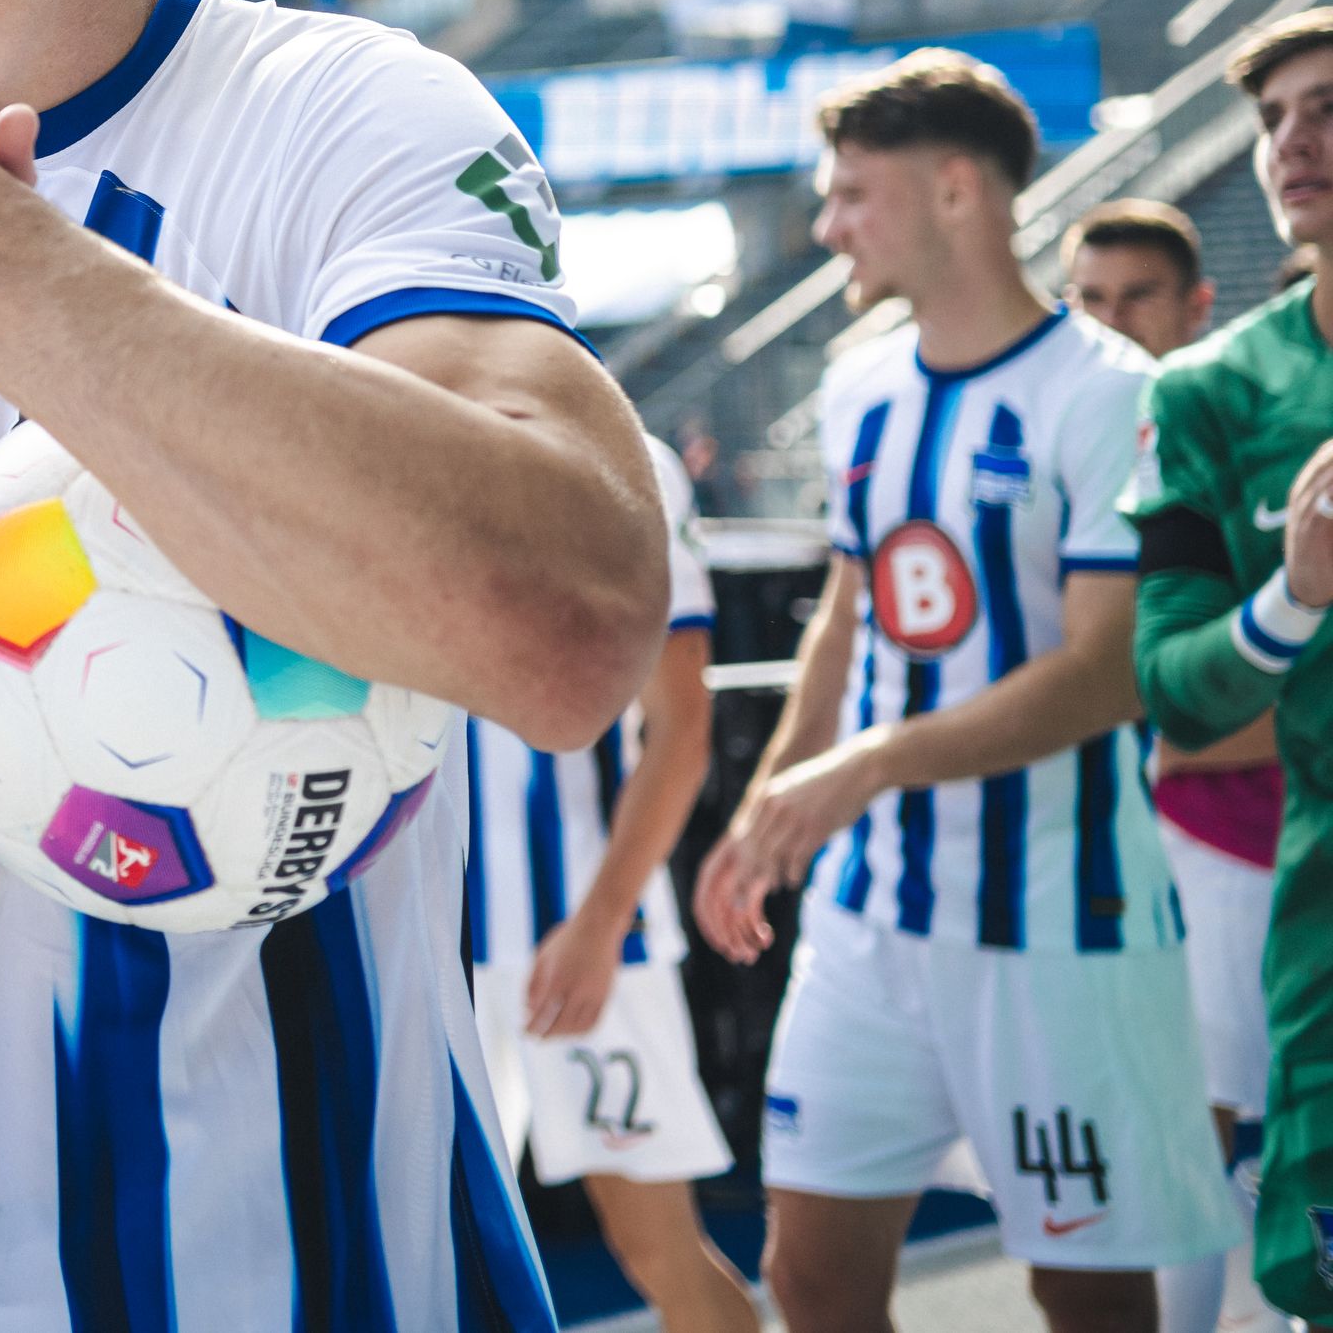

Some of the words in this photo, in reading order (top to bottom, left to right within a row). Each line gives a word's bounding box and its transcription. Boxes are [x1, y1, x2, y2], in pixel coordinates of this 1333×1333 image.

[889, 543, 956, 637] B
[565, 1048, 654, 1135] 22
[1012, 1105, 1109, 1205] 44
